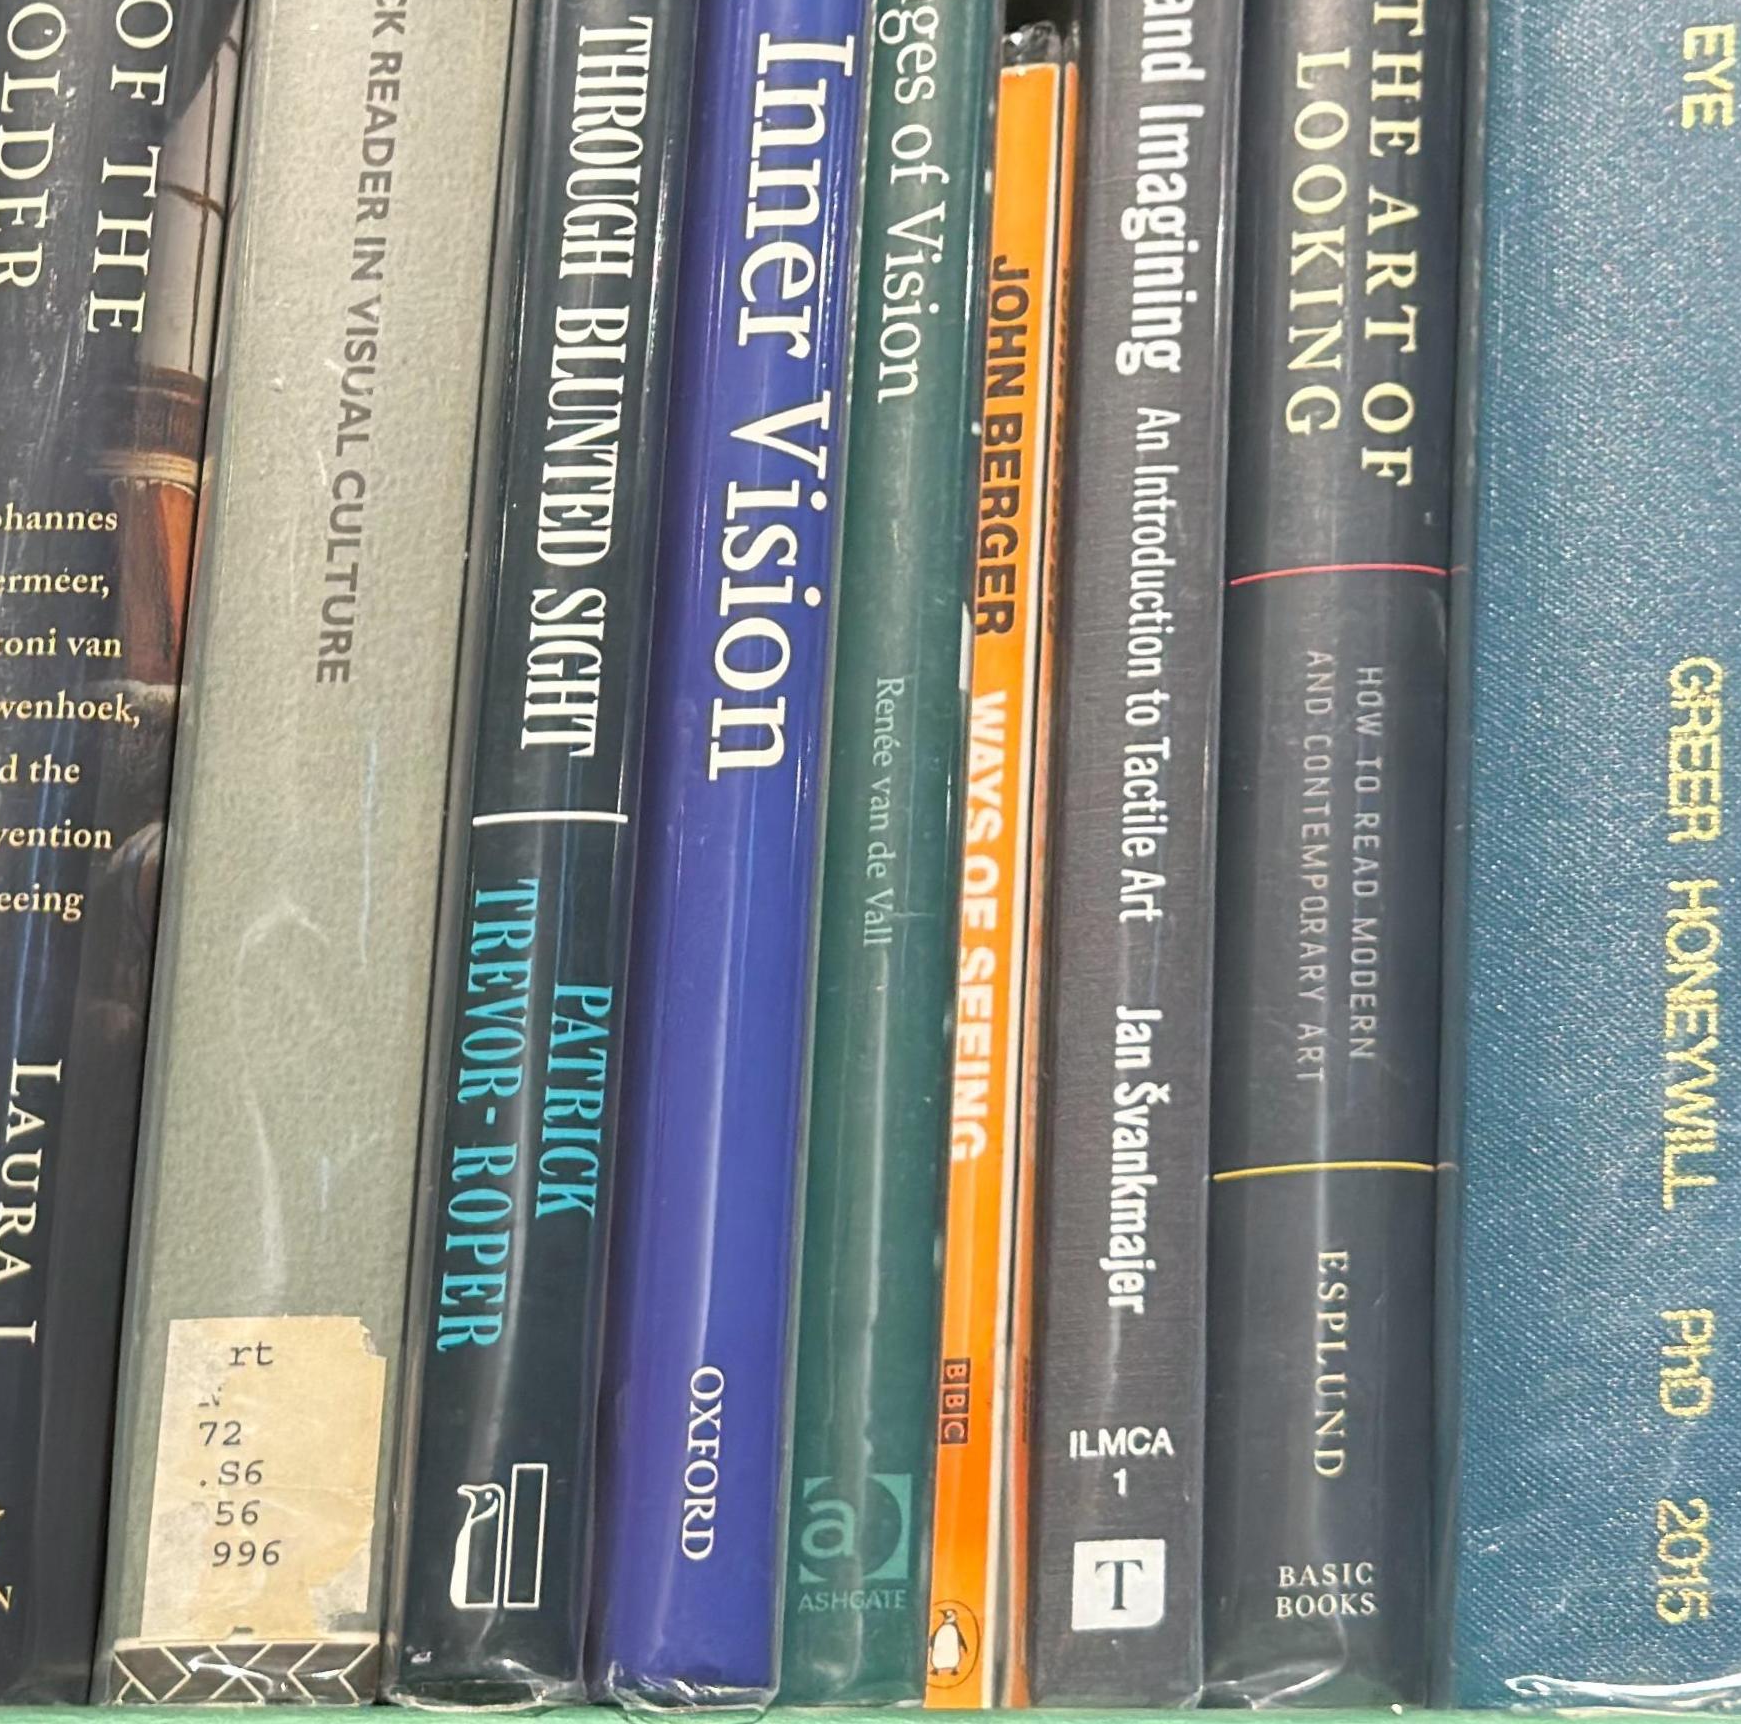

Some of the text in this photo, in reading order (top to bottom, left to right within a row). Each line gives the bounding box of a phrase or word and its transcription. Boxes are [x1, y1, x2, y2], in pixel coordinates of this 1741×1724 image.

[1679, 23, 1739, 130] EYE
[87, 146, 161, 335] THE
[736, 32, 853, 359] Inner
[1117, 105, 1207, 378] Imagining
[1284, 51, 1354, 437] LOOKING
[1361, 188, 1419, 353] ART
[1359, 382, 1417, 487] OF
[67, 634, 122, 657] van
[707, 392, 832, 782] Vision
[30, 755, 80, 784] the
[950, 254, 1030, 1161] JOHN BERGER WAYS OF SEEING
[1668, 655, 1724, 845] GREER
[535, 983, 614, 1217] PATRICK
[1661, 881, 1720, 1209] HONEYWILL
[941, 1357, 971, 1445] BBC
[1070, 1428, 1174, 1459] ILMCA
[1313, 1250, 1349, 1478] ESPLUND
[1659, 1307, 1715, 1419] PhD
[680, 1365, 725, 1560] OXFORD
[798, 1590, 907, 1613] ASHGATE
[1274, 1592, 1375, 1618] BOOKS
[1277, 1563, 1374, 1588] BASIC
[1655, 1498, 1710, 1624] 2015
